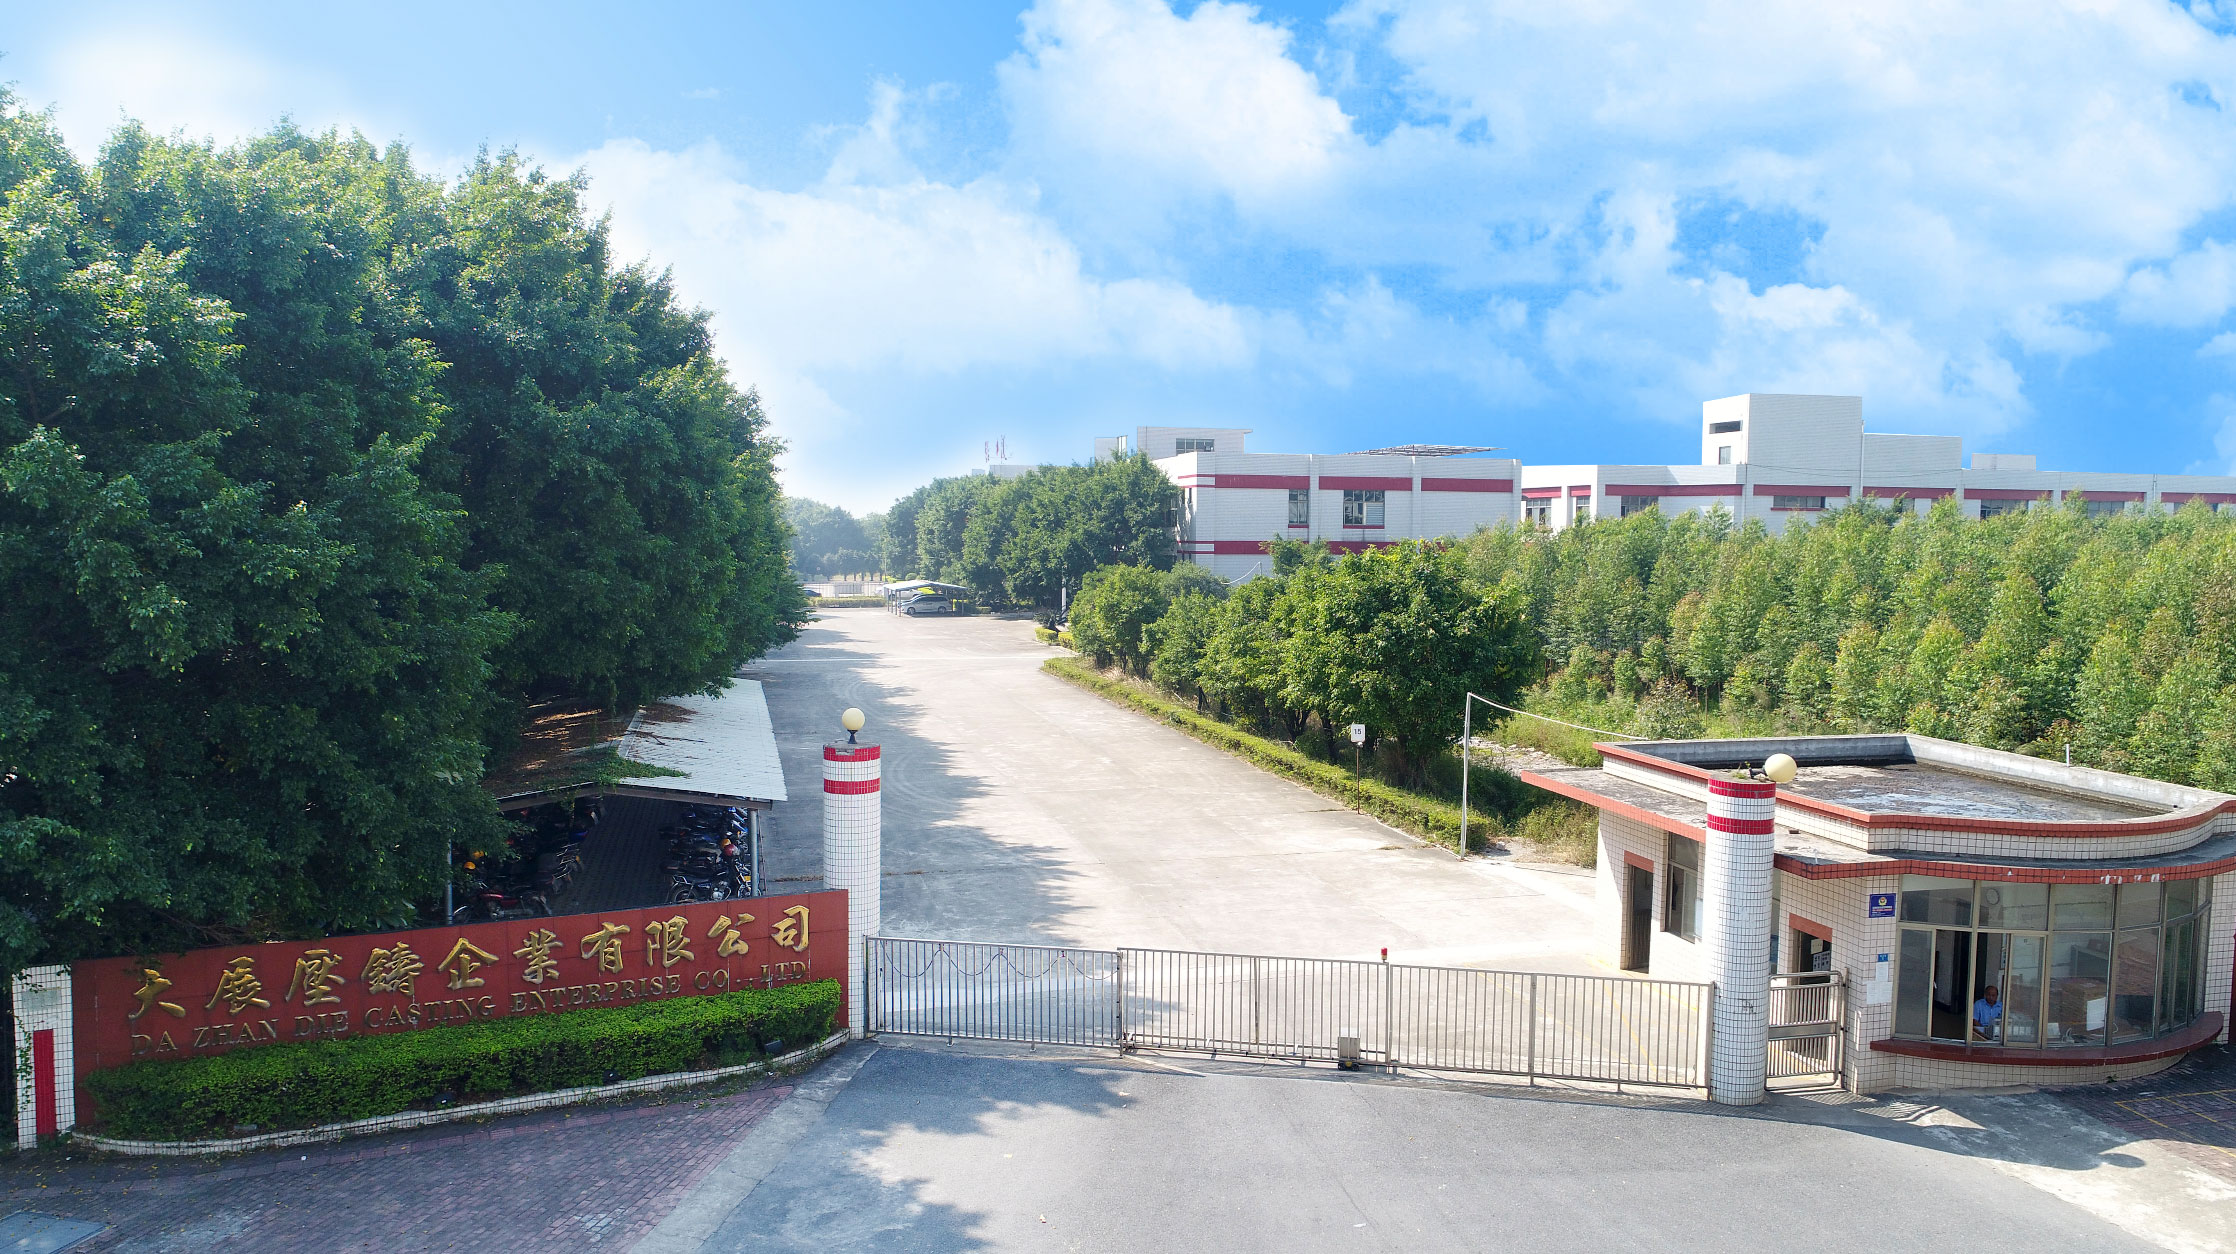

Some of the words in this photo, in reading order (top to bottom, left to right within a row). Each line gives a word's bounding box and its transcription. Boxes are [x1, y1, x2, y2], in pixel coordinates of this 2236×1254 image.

[131, 1030, 178, 1056] DA
[193, 1018, 280, 1048] ZHAN
[294, 1010, 348, 1037] DIE
[364, 995, 497, 1028] CASTING
[511, 974, 681, 1013] ENTERPRISE
